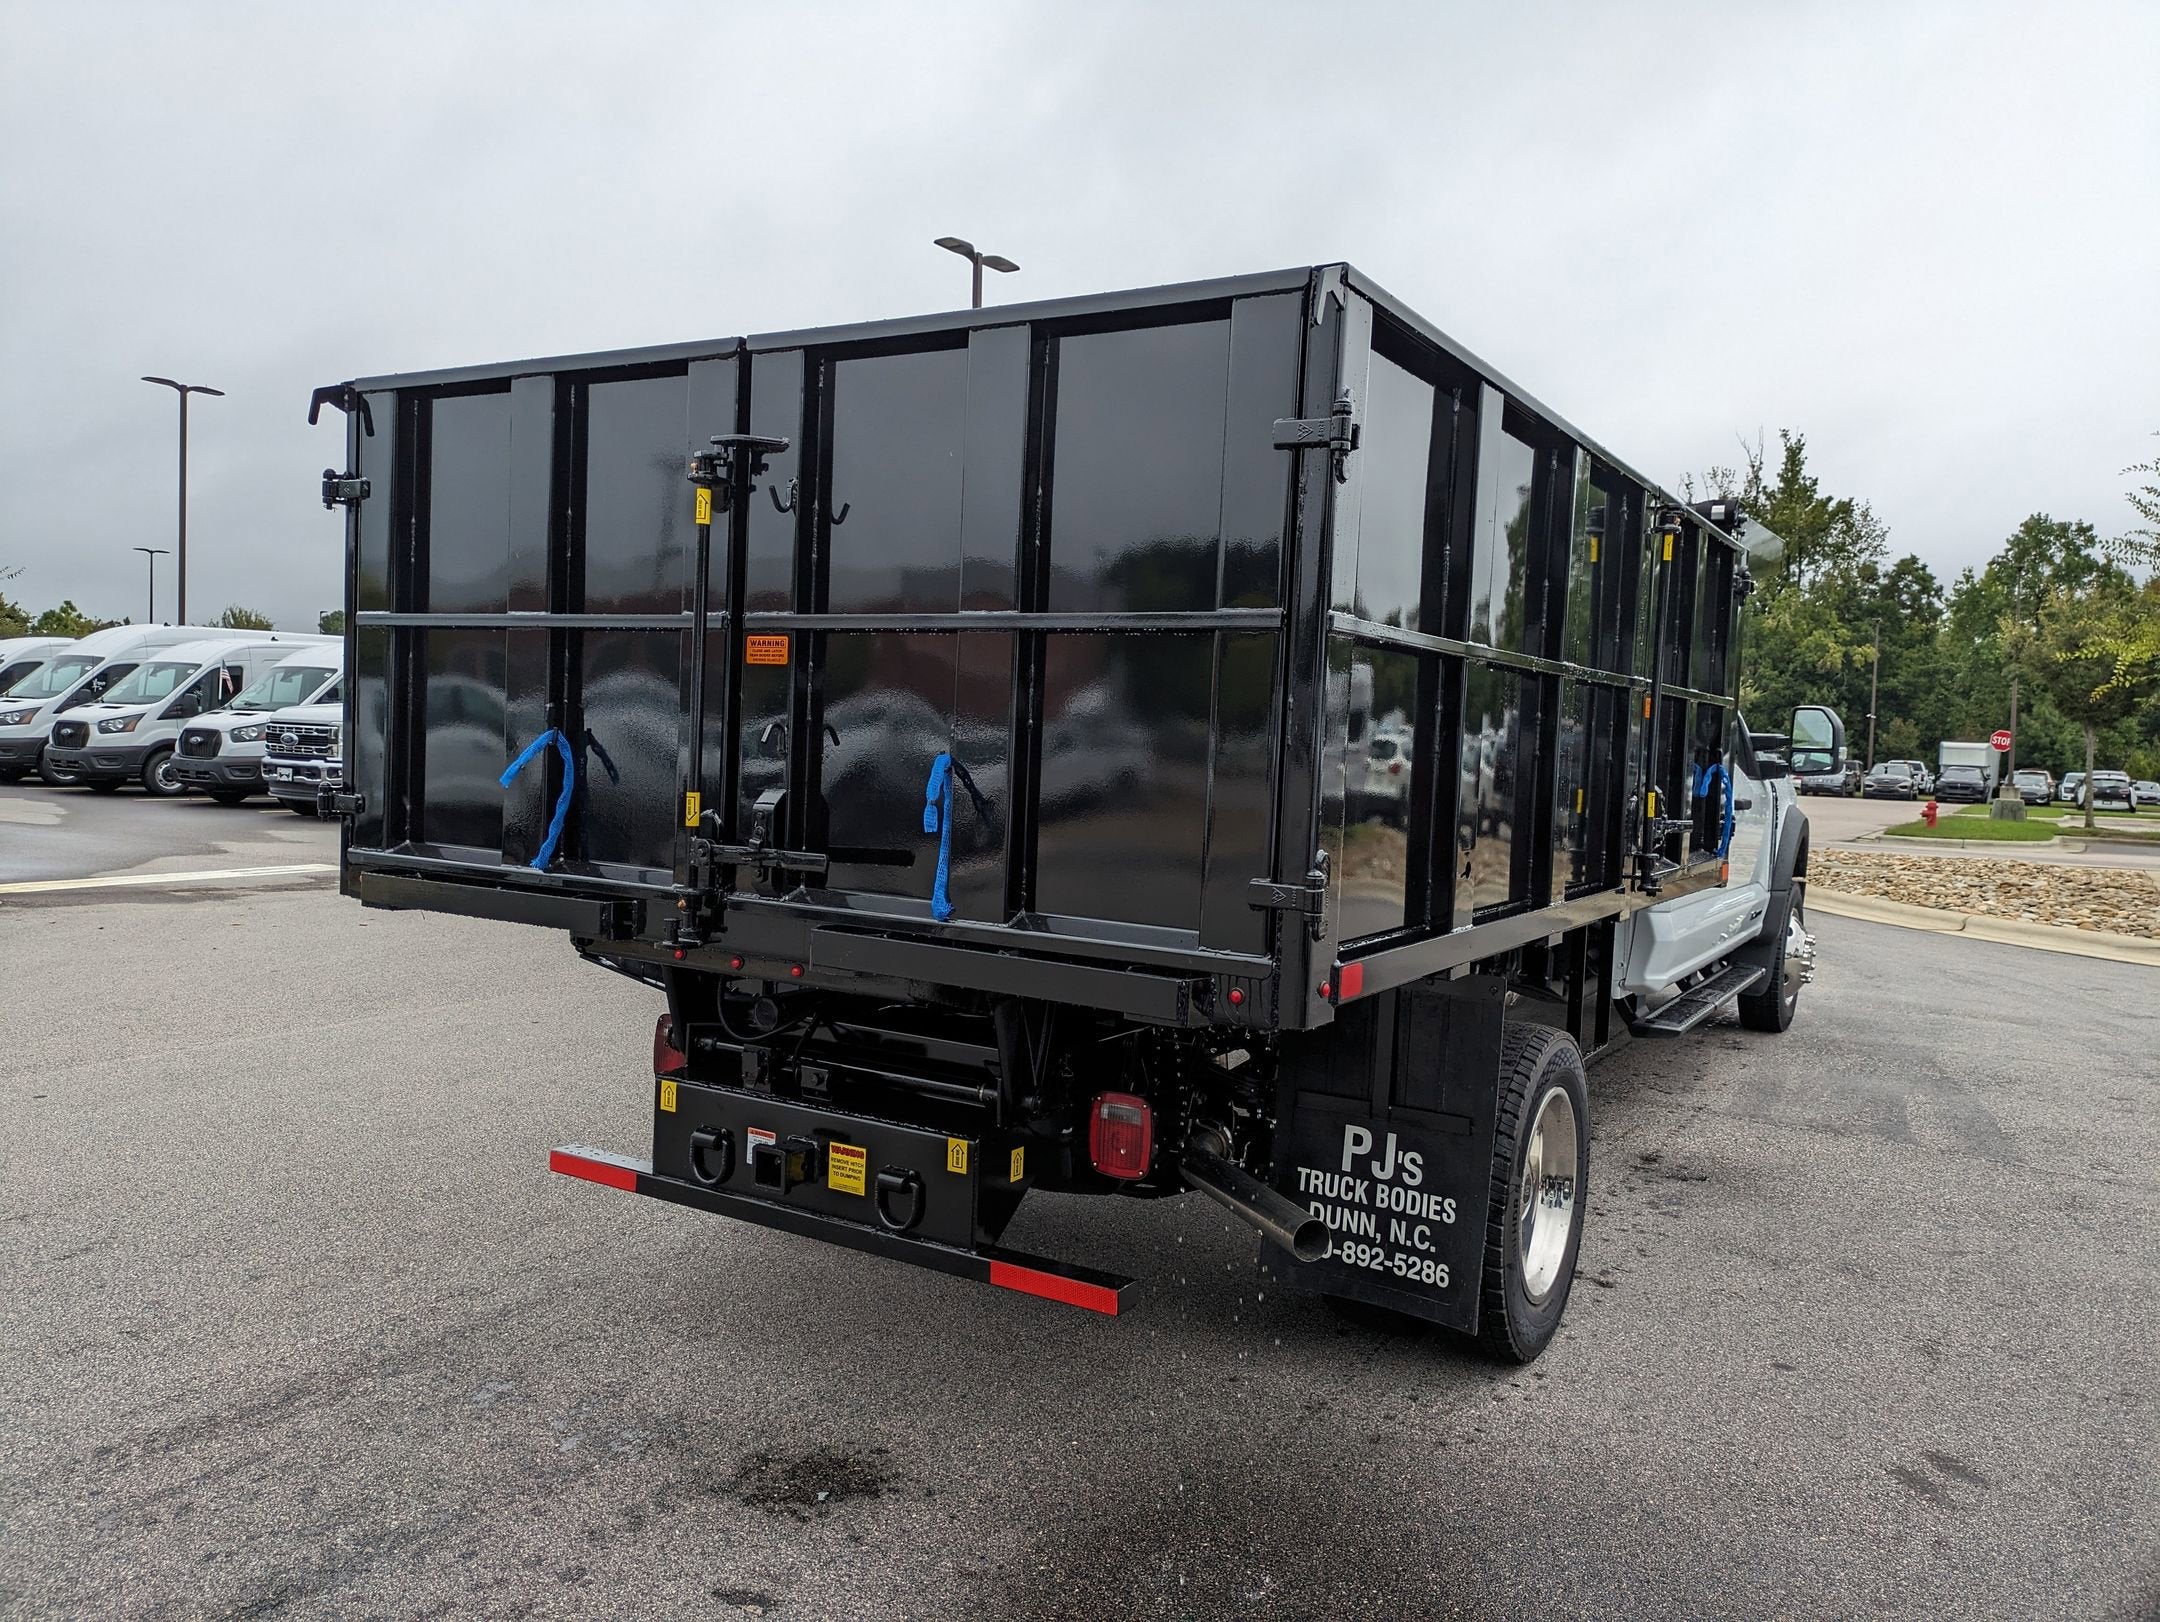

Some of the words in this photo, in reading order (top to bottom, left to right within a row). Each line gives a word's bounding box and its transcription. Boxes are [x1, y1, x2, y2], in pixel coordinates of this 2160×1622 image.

[750, 639, 785, 647] WARNING
[831, 1157, 849, 1165] REMOVE
[850, 1161, 865, 1169] HITCH
[832, 1164, 848, 1172] INSERT
[848, 1167, 863, 1175] PRIOR
[840, 1172, 861, 1181] DUMPING
[1297, 1166, 1370, 1205] TRUCK
[1375, 1183, 1457, 1225] BODIES
[1309, 1201, 1381, 1244] DUNN,
[1389, 1218, 1436, 1253] N.C.
